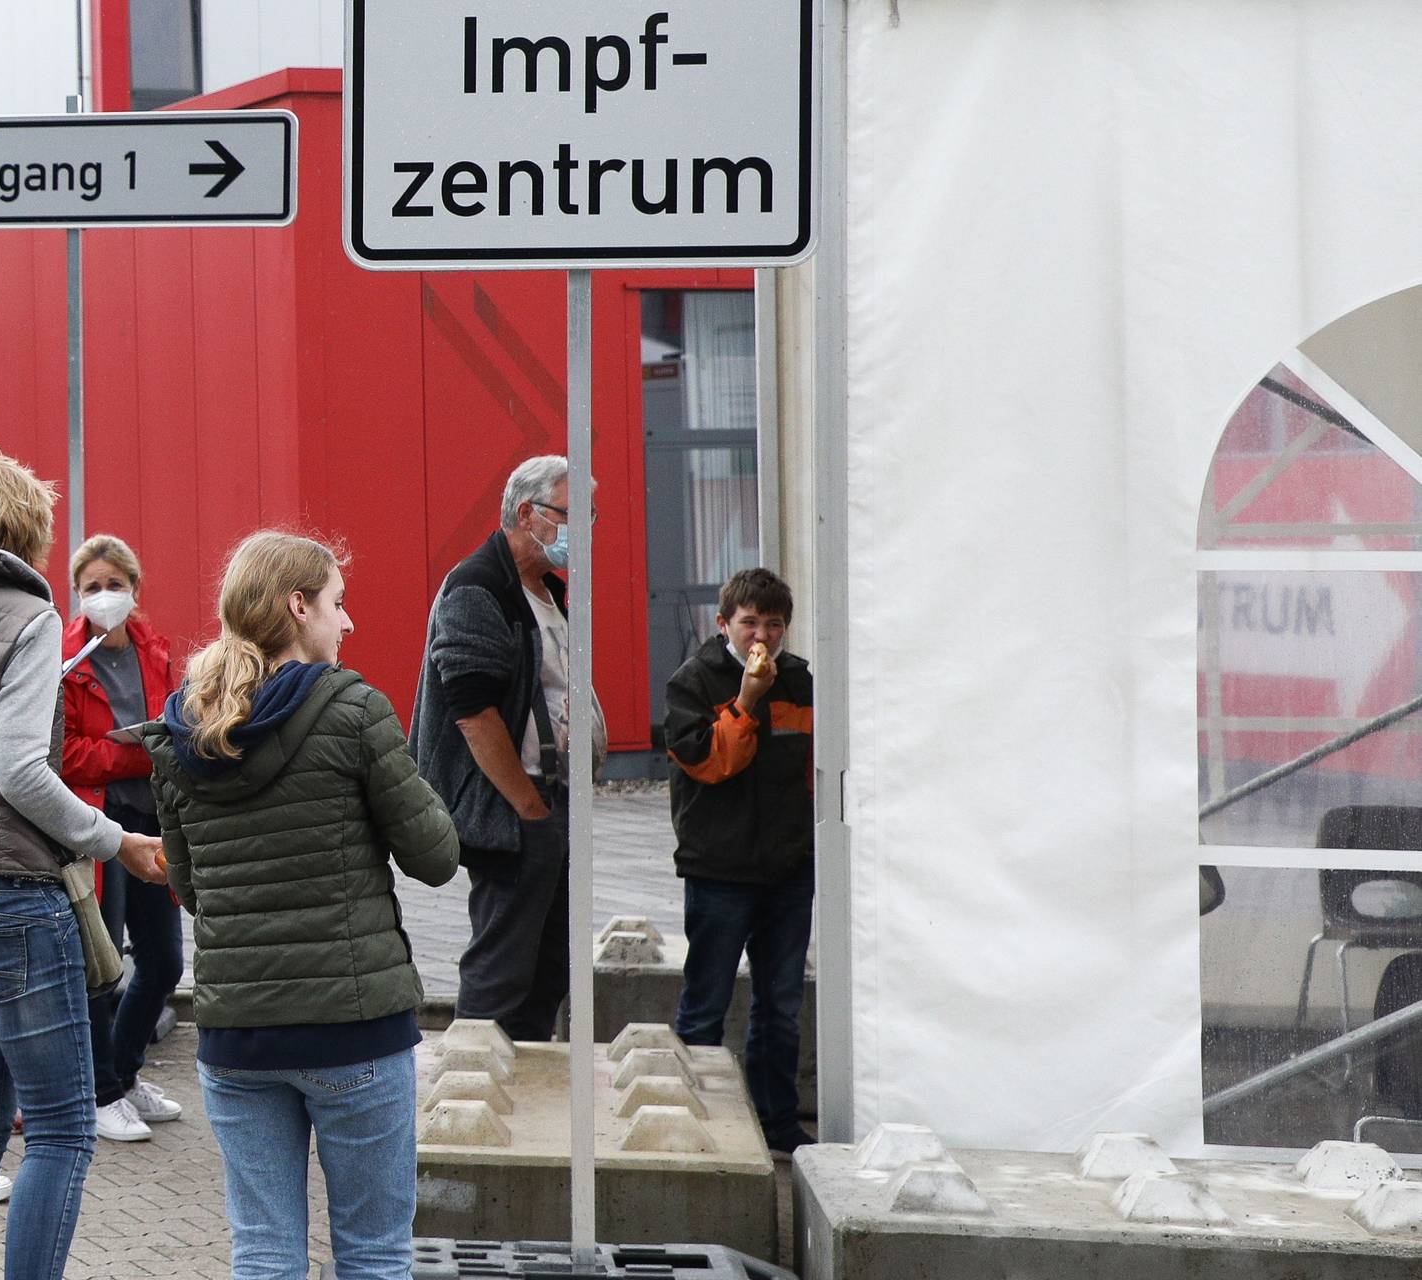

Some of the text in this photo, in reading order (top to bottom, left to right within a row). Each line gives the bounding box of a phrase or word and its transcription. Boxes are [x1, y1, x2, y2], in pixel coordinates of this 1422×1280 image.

[463, 12, 708, 114] Impf-
[123, 150, 137, 191] 1
[391, 143, 774, 218] zentrum
